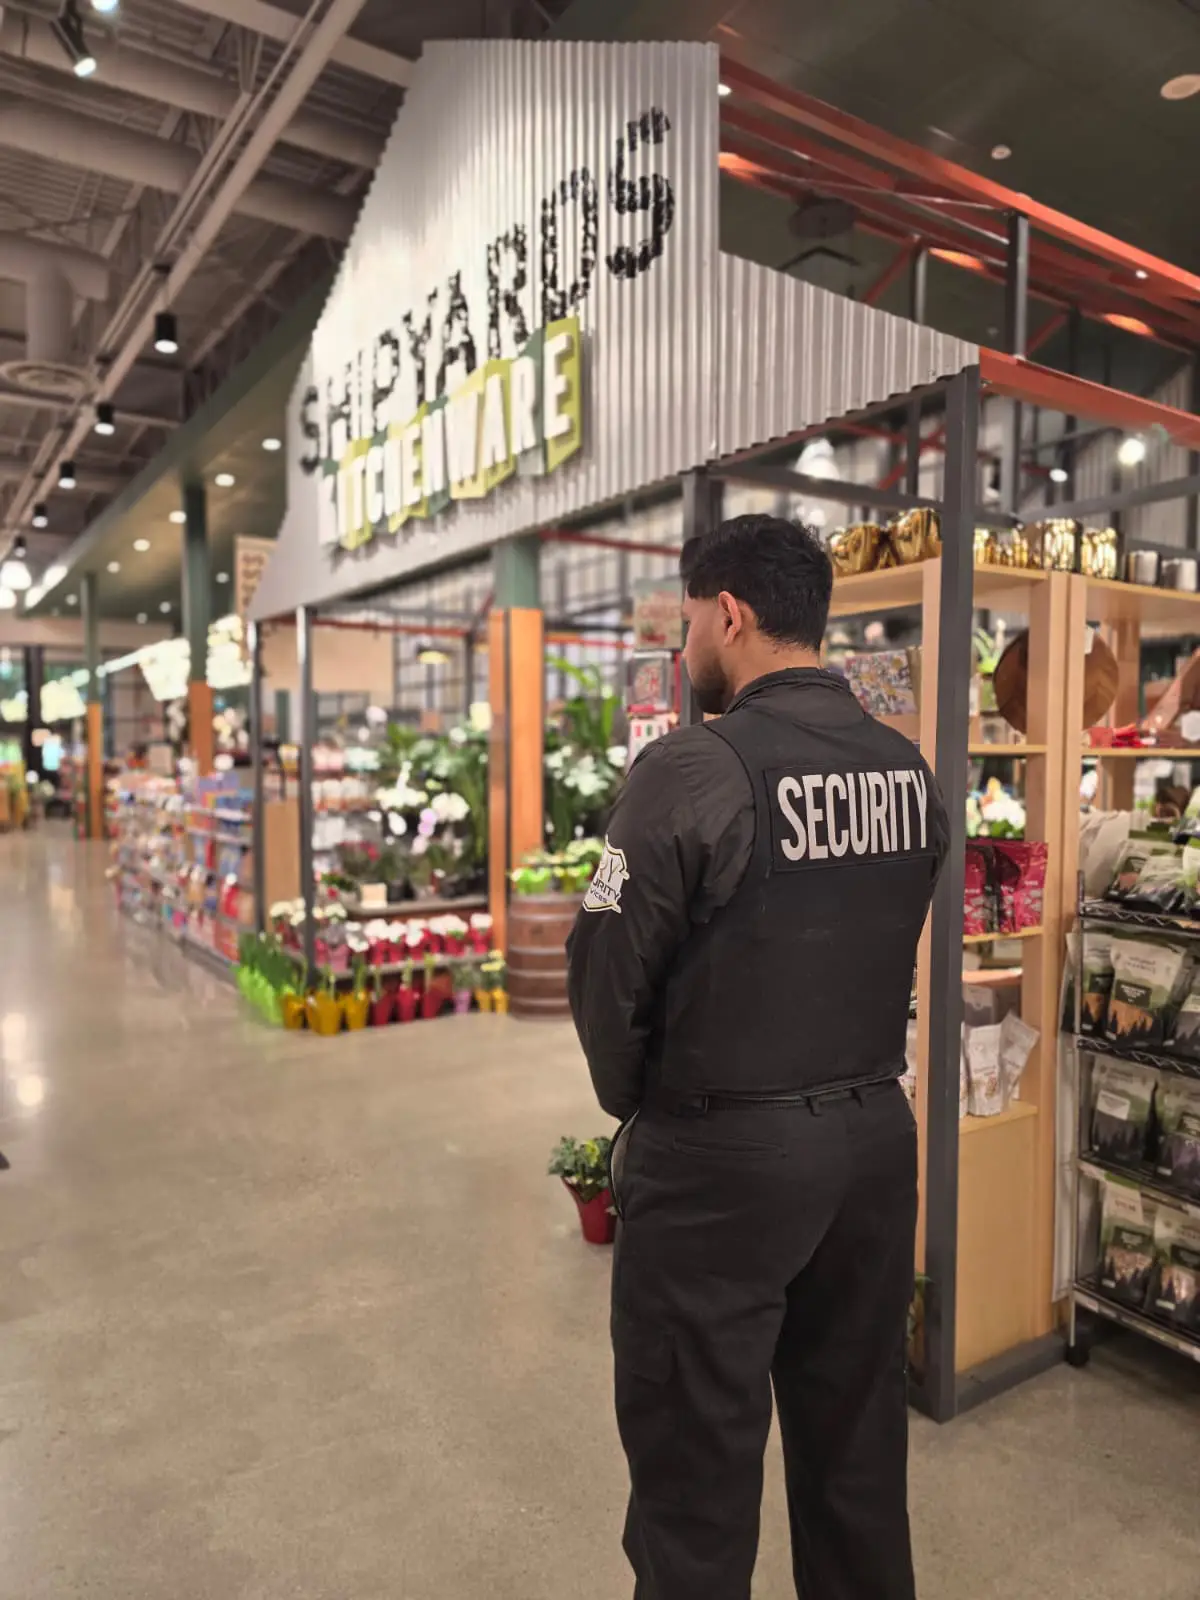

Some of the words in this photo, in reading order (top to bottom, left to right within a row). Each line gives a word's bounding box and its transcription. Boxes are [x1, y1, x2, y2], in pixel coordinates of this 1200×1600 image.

[299, 106, 675, 473] SHIPYARDS
[318, 331, 573, 545] KITCHENWARE
[592, 879, 620, 900] URITY
[777, 769, 927, 861] SECURITY
